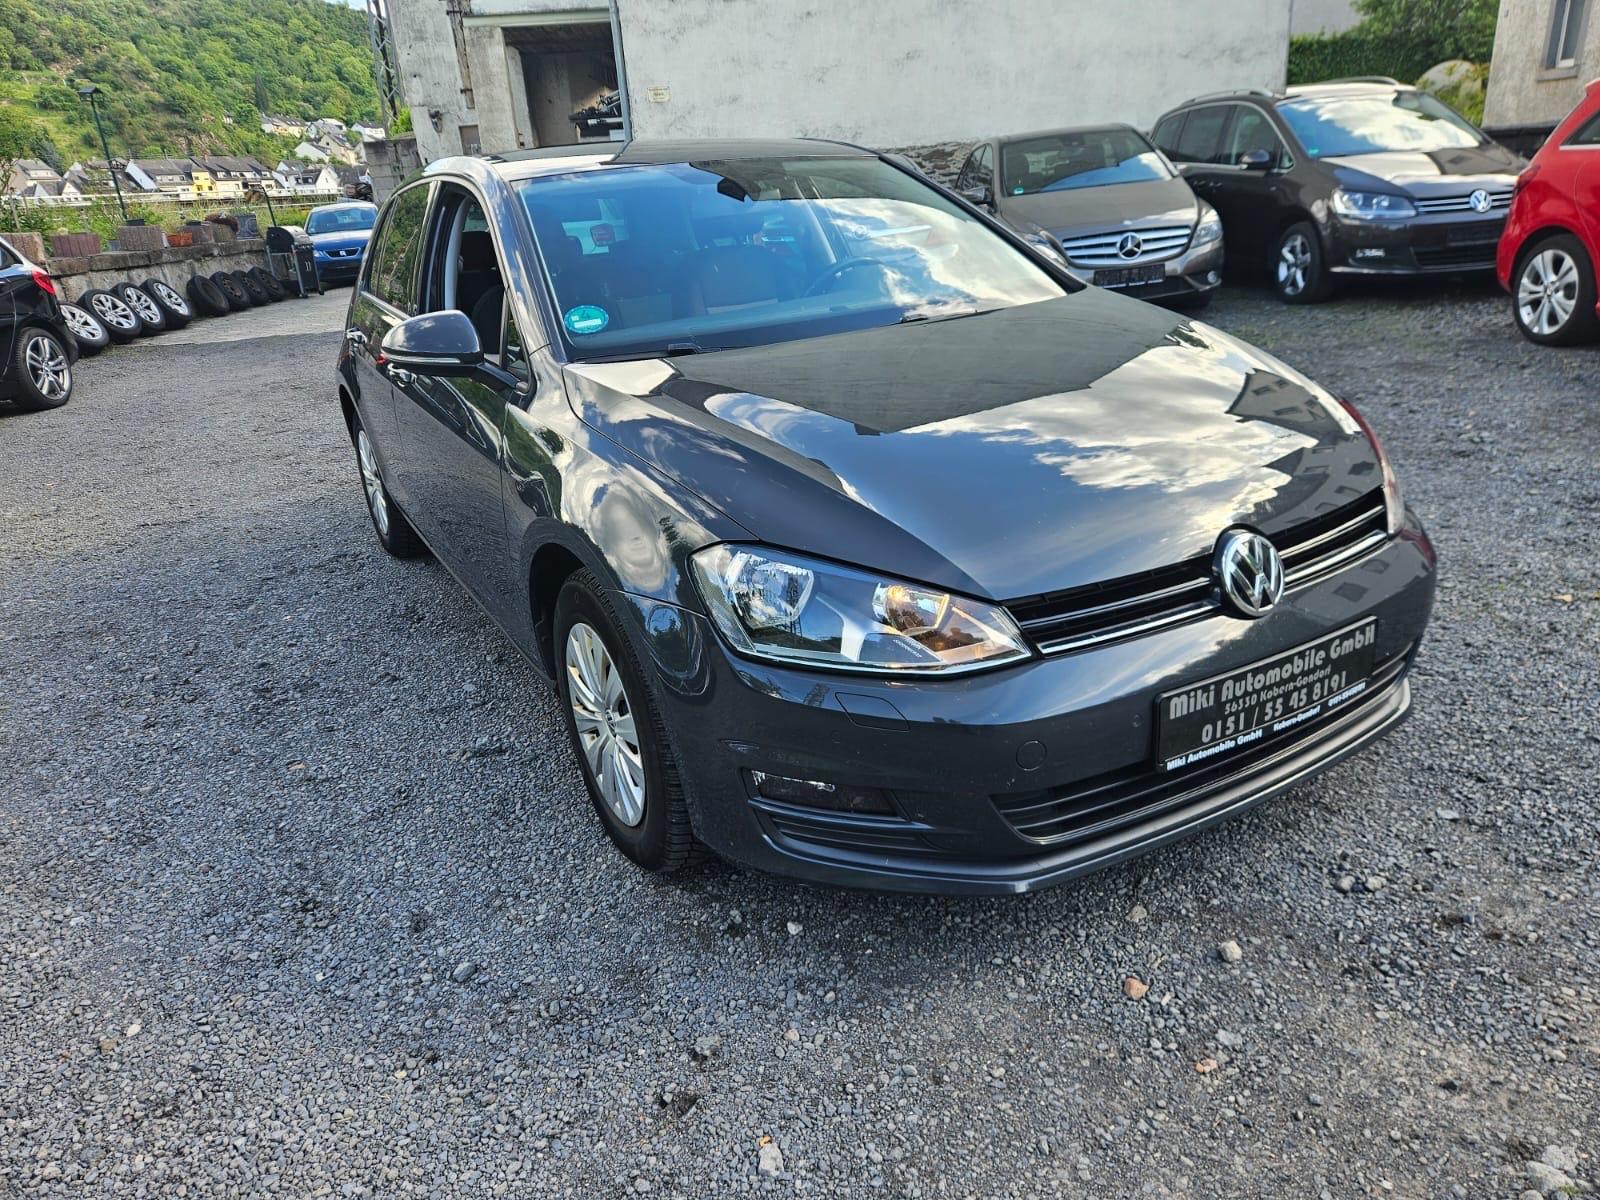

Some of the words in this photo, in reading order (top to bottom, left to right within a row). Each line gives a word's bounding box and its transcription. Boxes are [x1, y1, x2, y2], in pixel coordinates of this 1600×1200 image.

[1170, 685, 1215, 720] Miki
[1221, 648, 1326, 701] Automobile
[1329, 624, 1376, 660] GmbH
[1224, 694, 1258, 715] 56330
[1260, 664, 1332, 702] Kobern-Gondorf
[1201, 711, 1245, 744] 0151
[1264, 698, 1283, 721] 55
[1288, 688, 1308, 710] 45
[1312, 670, 1347, 701] 8191
[1166, 756, 1187, 771] Miki
[1187, 740, 1236, 764] Automobile
[1236, 729, 1263, 745] GmbH
